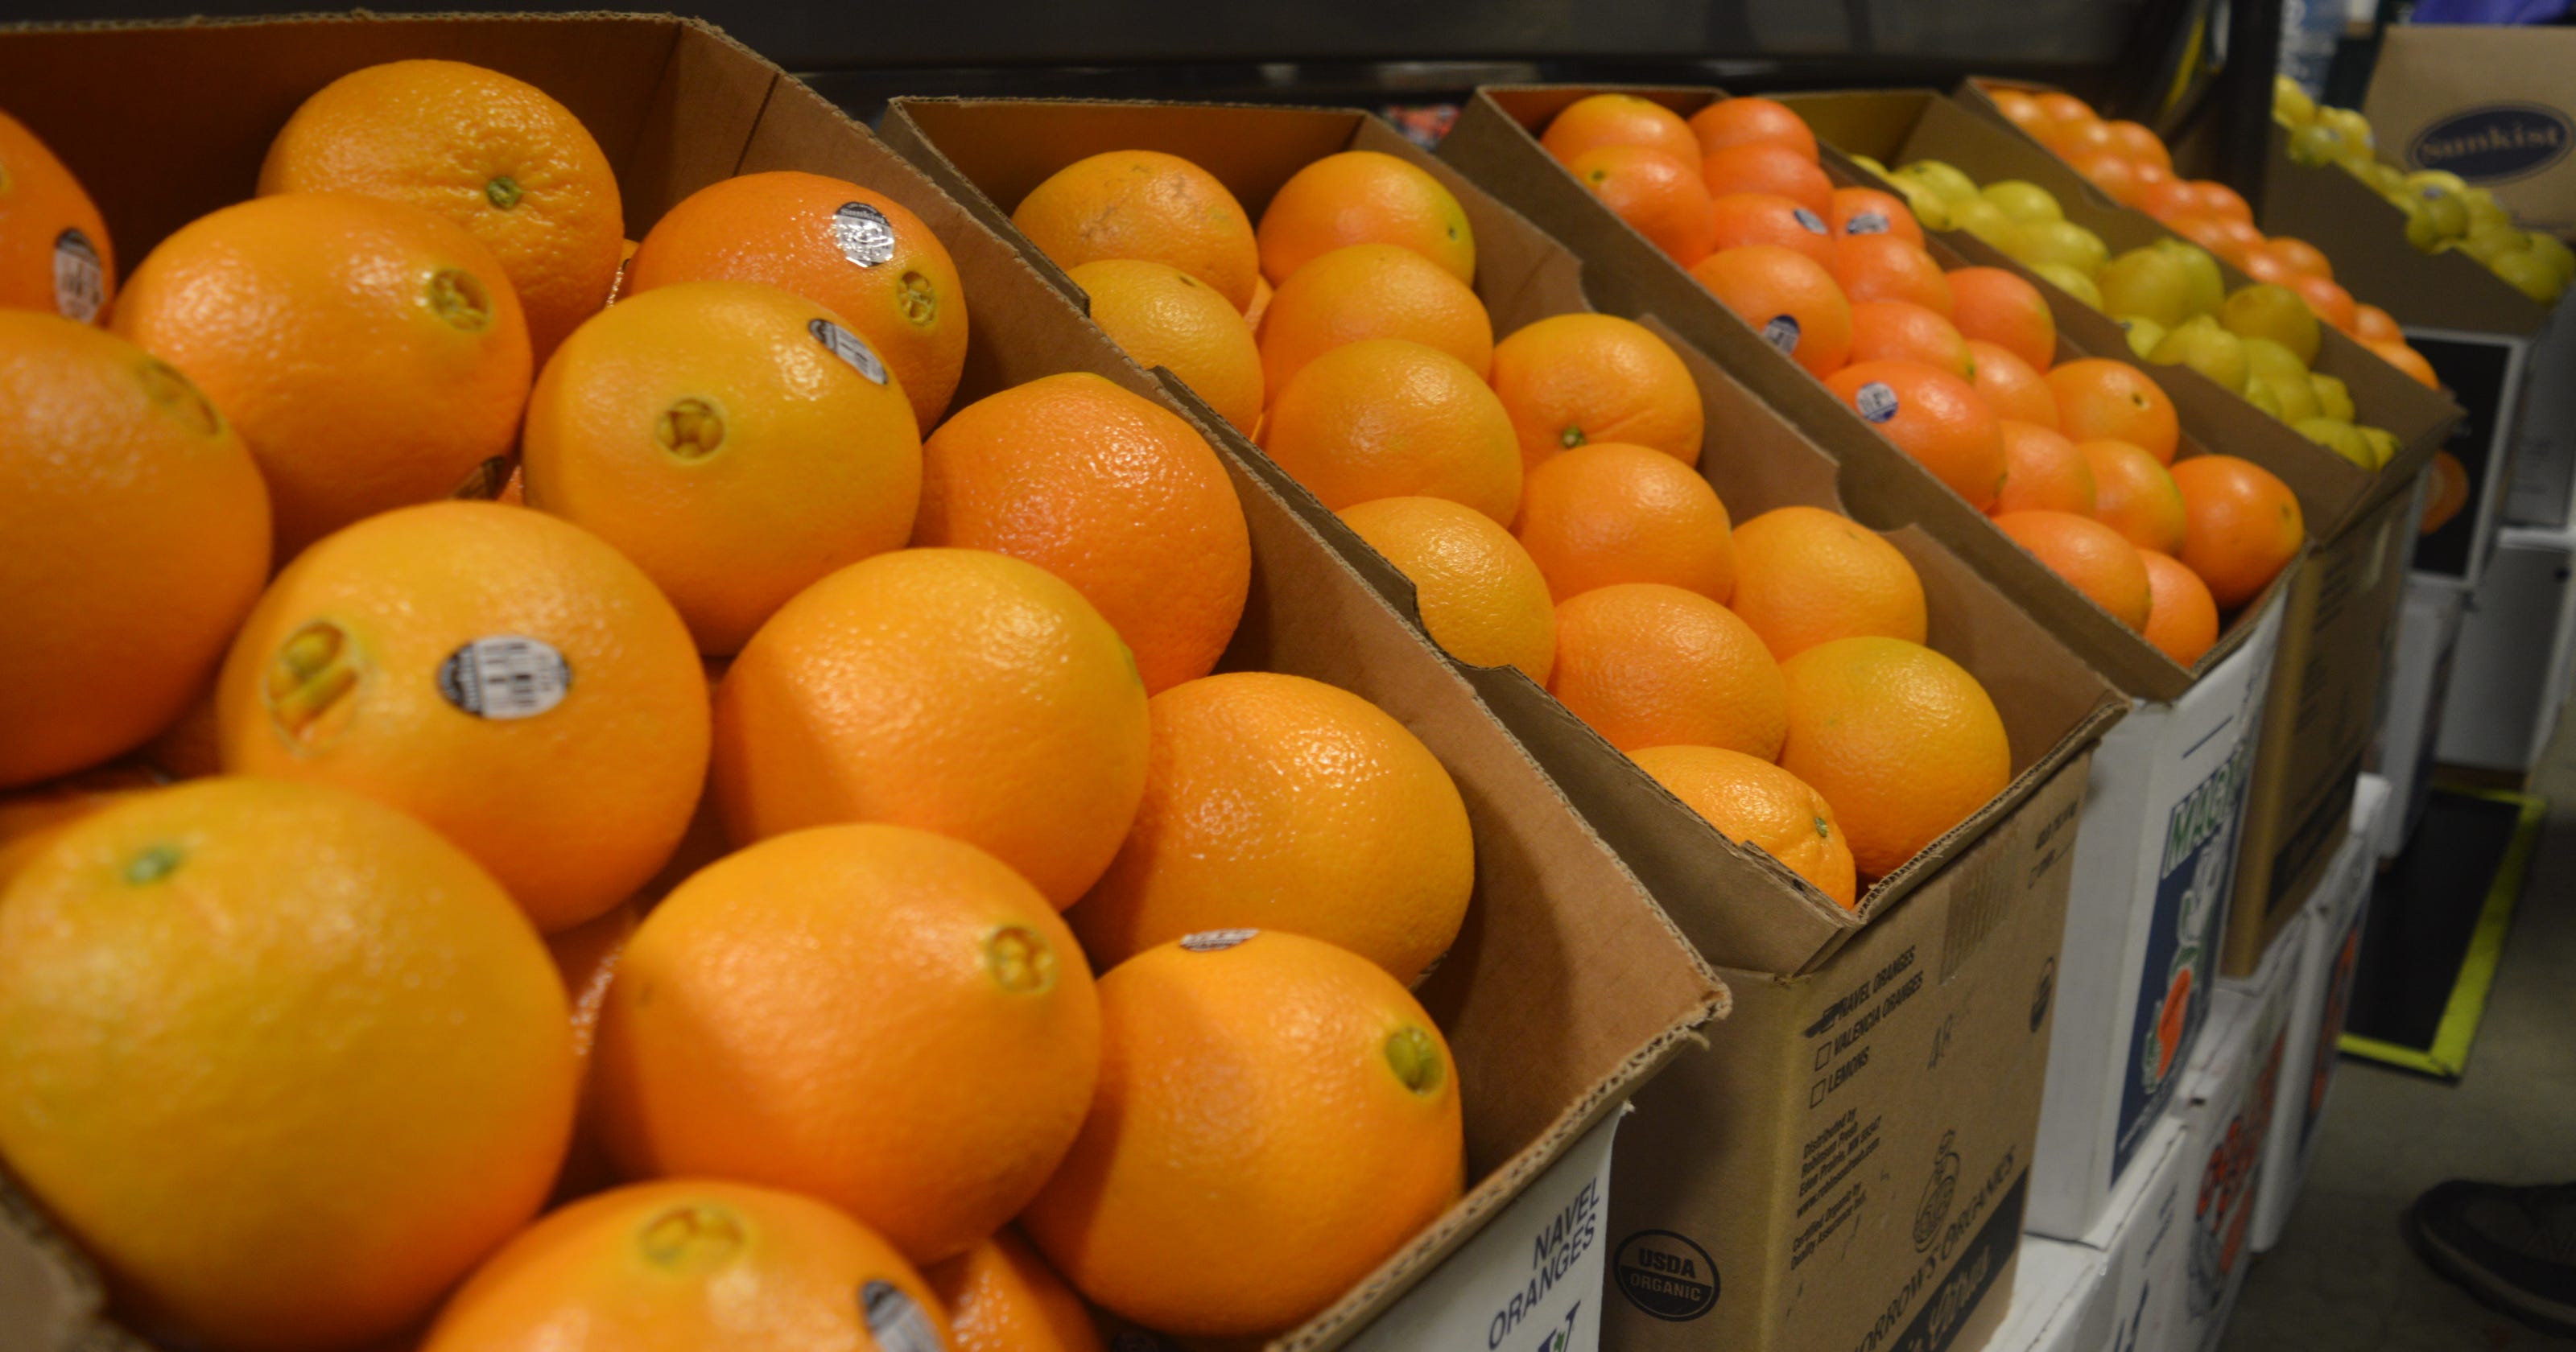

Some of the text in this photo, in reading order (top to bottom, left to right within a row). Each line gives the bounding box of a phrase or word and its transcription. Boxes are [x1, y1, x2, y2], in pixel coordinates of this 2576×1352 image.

[2421, 122, 2557, 159] Sunkist
[1835, 1005, 1881, 1057] VALENCIA
[1828, 1047, 1869, 1094] LEMONS
[1534, 1177, 1600, 1270] NAVEL
[1488, 1214, 1596, 1351] ORANGES
[1630, 1272, 1701, 1301] ORGANIC
[1639, 1247, 1696, 1279] USDA
[1855, 1244, 1939, 1352] ORROW'S
